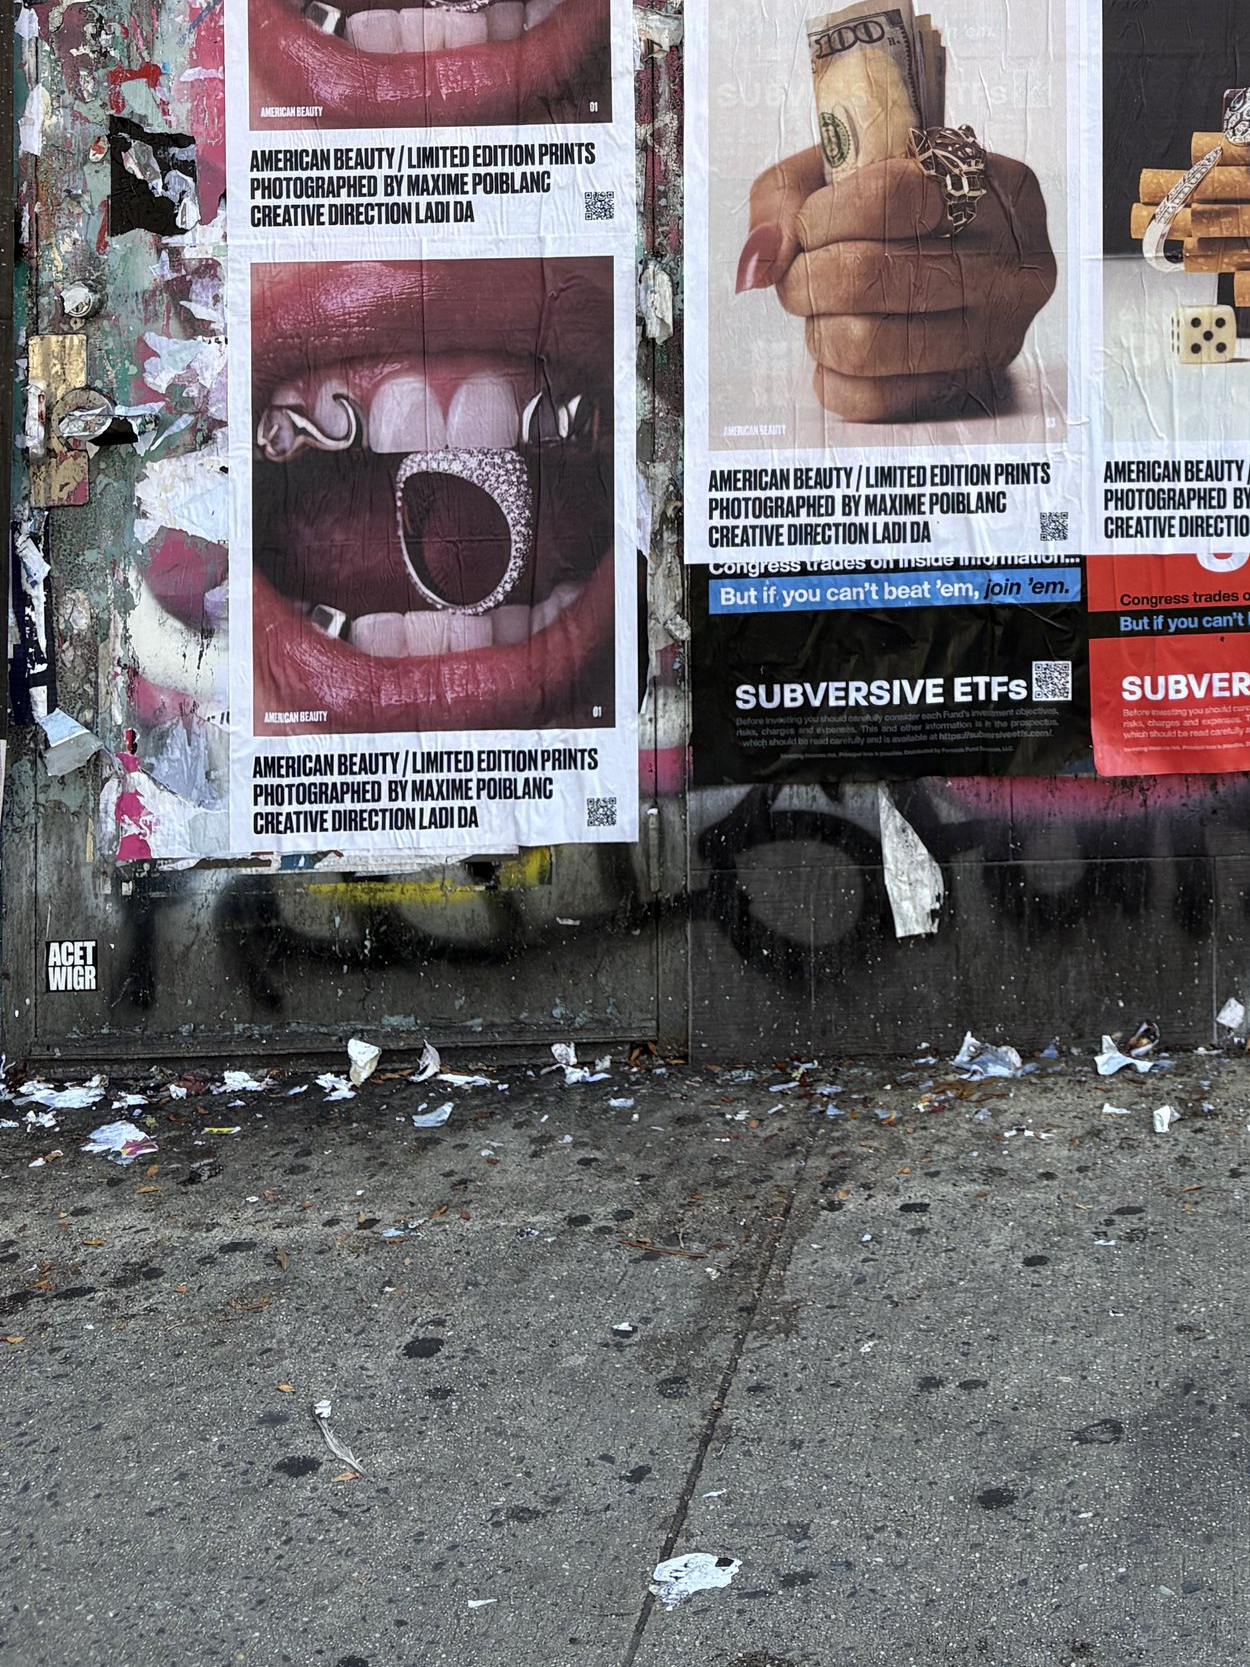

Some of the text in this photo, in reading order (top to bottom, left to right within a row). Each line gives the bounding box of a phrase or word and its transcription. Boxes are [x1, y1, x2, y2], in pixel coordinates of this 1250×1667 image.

[814, 19, 886, 59] 100
[260, 106, 323, 118] AMERICAN BEAUTY
[589, 101, 599, 112] 01
[250, 148, 330, 171] AMERICAN
[333, 147, 394, 170] BEAUTY
[407, 145, 469, 168] LIMITED
[472, 144, 535, 166] EDITION
[538, 142, 595, 164] PRINTS
[250, 171, 550, 199] PHOTOGRAPHED BY MAXIME POIBLANC
[250, 200, 474, 226] CREATIVE DIRECTION LADI DA
[1104, 460, 1180, 482] AMERICAN
[1184, 459, 1243, 481] BEAUTY
[1104, 487, 1226, 510] PHOTOGRAPHED
[1104, 515, 1175, 538] CREATIVE
[720, 587, 757, 606] But
[762, 586, 777, 604] if
[781, 588, 821, 608] you
[826, 584, 879, 603] can't
[883, 582, 931, 600] beat
[983, 578, 1022, 600] join
[1120, 593, 1189, 608] Congress
[1193, 591, 1239, 604] trades
[1120, 616, 1149, 631] But
[1153, 615, 1164, 630] if
[1168, 618, 1198, 632] you
[1202, 612, 1245, 628] can't
[735, 675, 1027, 711] SUBVERSIVE ETFs
[264, 711, 327, 724] AMERICAN BEAUTY
[592, 706, 602, 717] 01
[48, 941, 96, 966] ACET
[48, 965, 96, 990] WIGR
